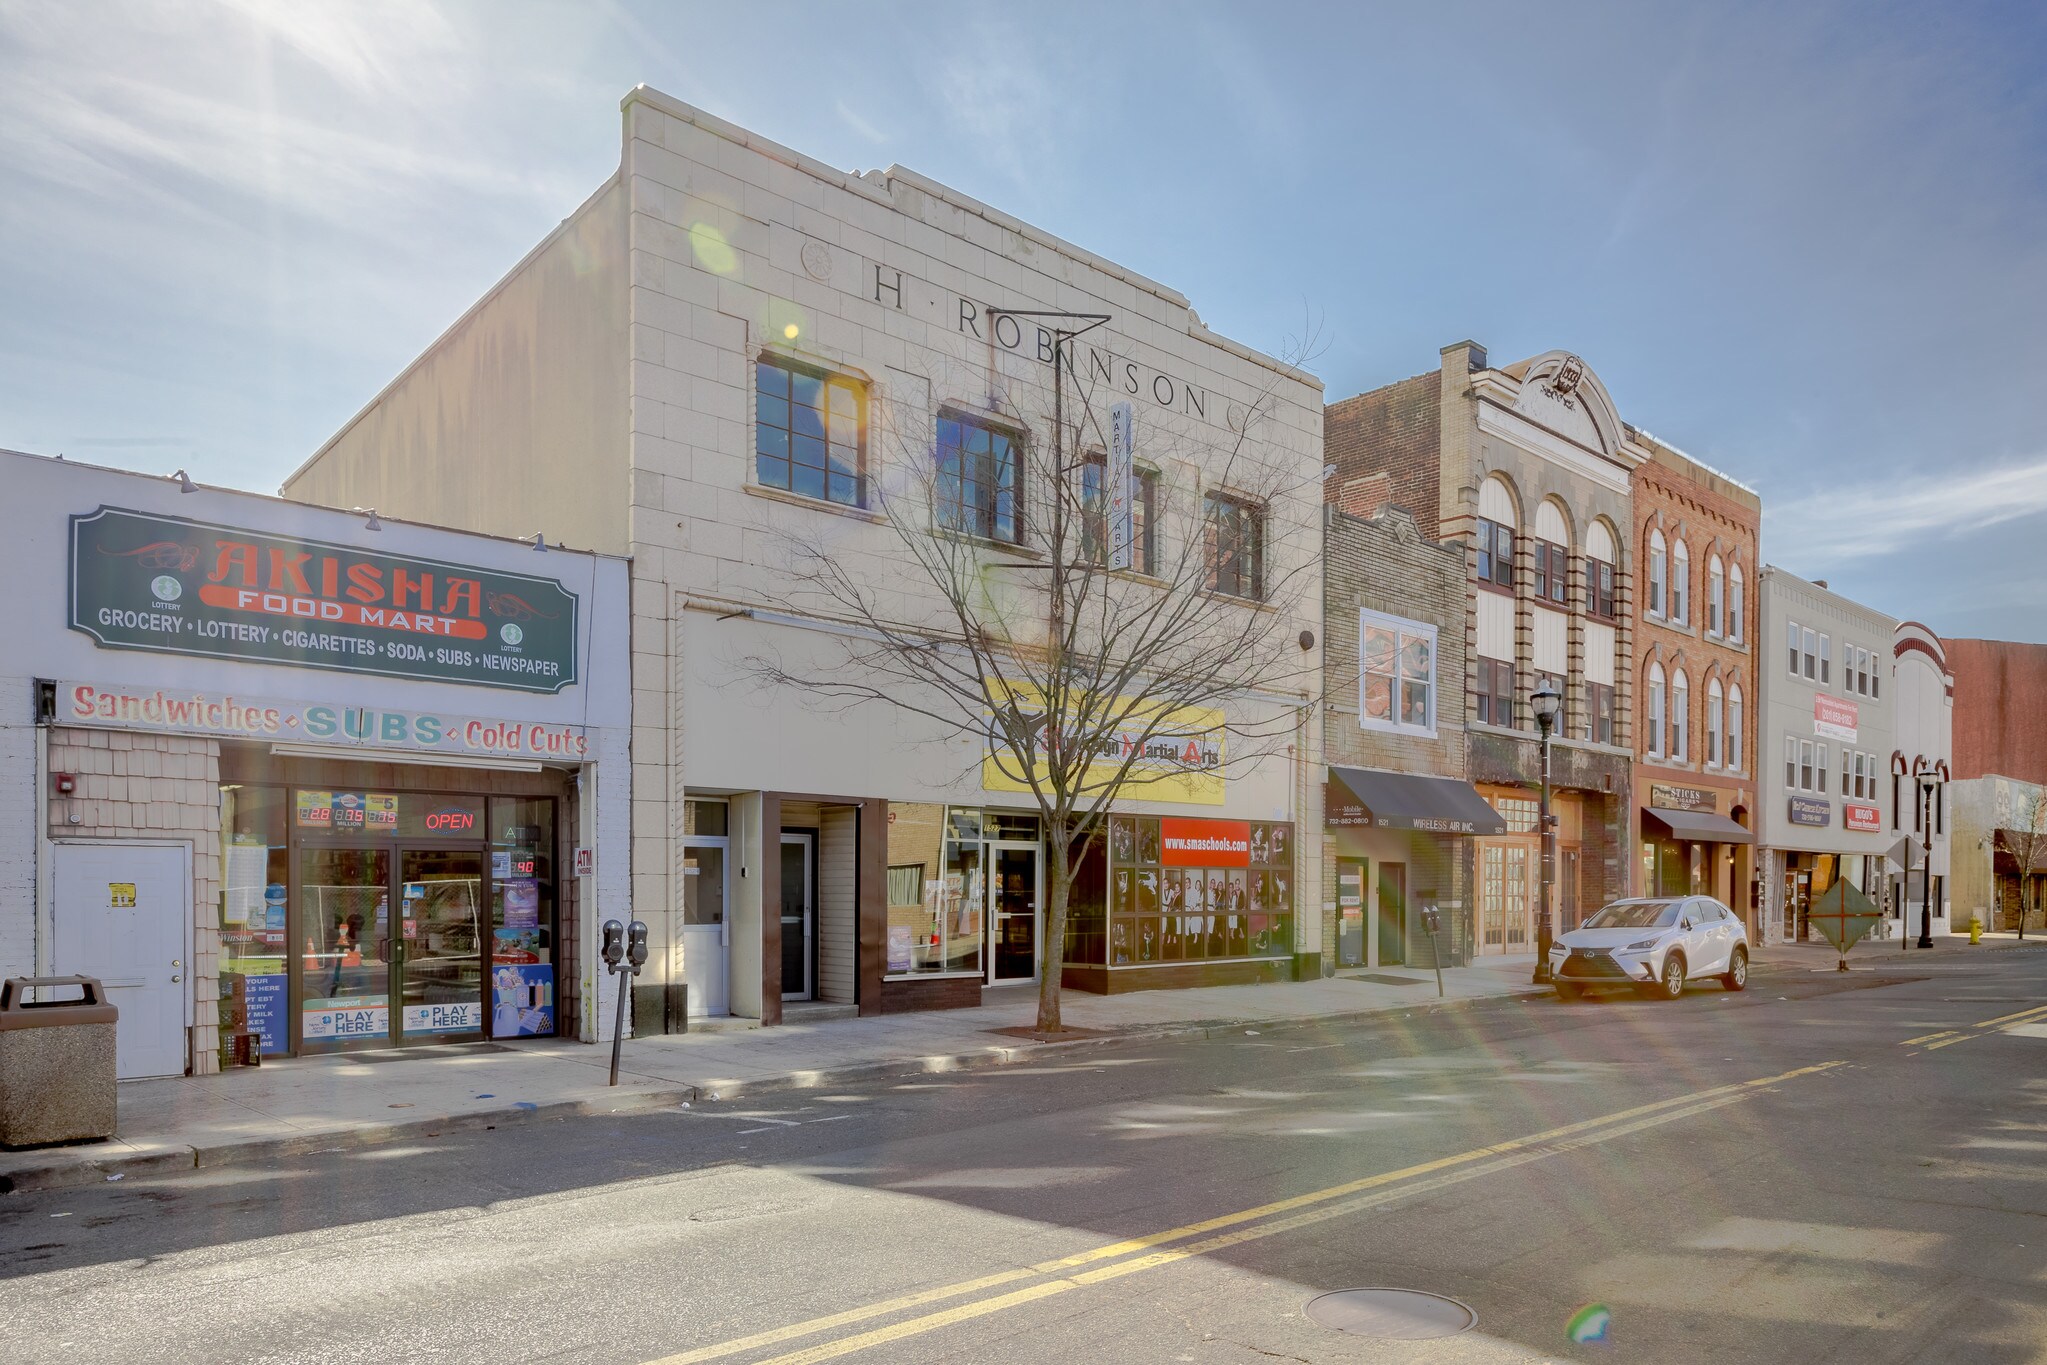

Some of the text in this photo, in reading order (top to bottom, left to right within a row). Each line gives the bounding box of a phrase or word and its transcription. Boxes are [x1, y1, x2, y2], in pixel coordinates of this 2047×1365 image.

[875, 265, 1205, 419] H ROBINSON
[207, 541, 481, 618] AKISHA
[151, 601, 182, 611] LOTTERY
[238, 590, 457, 634] FOOD MART
[98, 607, 559, 677] GROCERY LOTTERY CIGARETTES SODA SUBS NEWSPAPER
[500, 645, 523, 653] LOTTERY
[72, 685, 592, 755] Sandwiches SUBS Cold Cuts
[1122, 733, 1179, 761] Martial
[1180, 741, 1219, 766] Arts
[1670, 788, 1701, 800] STICKS
[425, 814, 474, 830] OPEN
[1413, 818, 1447, 830] WIRELESS
[1449, 821, 1460, 831] AIR
[1461, 822, 1475, 832] INC.
[1165, 836, 1248, 852] www.smaschools.com
[577, 850, 593, 867] ATM
[578, 867, 592, 875] INSIDE
[219, 933, 253, 942] Winston
[328, 1000, 361, 1008] Newport
[336, 1011, 374, 1023] PLAY
[433, 1006, 468, 1017] PLAY
[336, 1021, 374, 1034] HERE
[433, 1016, 468, 1027] HERE
